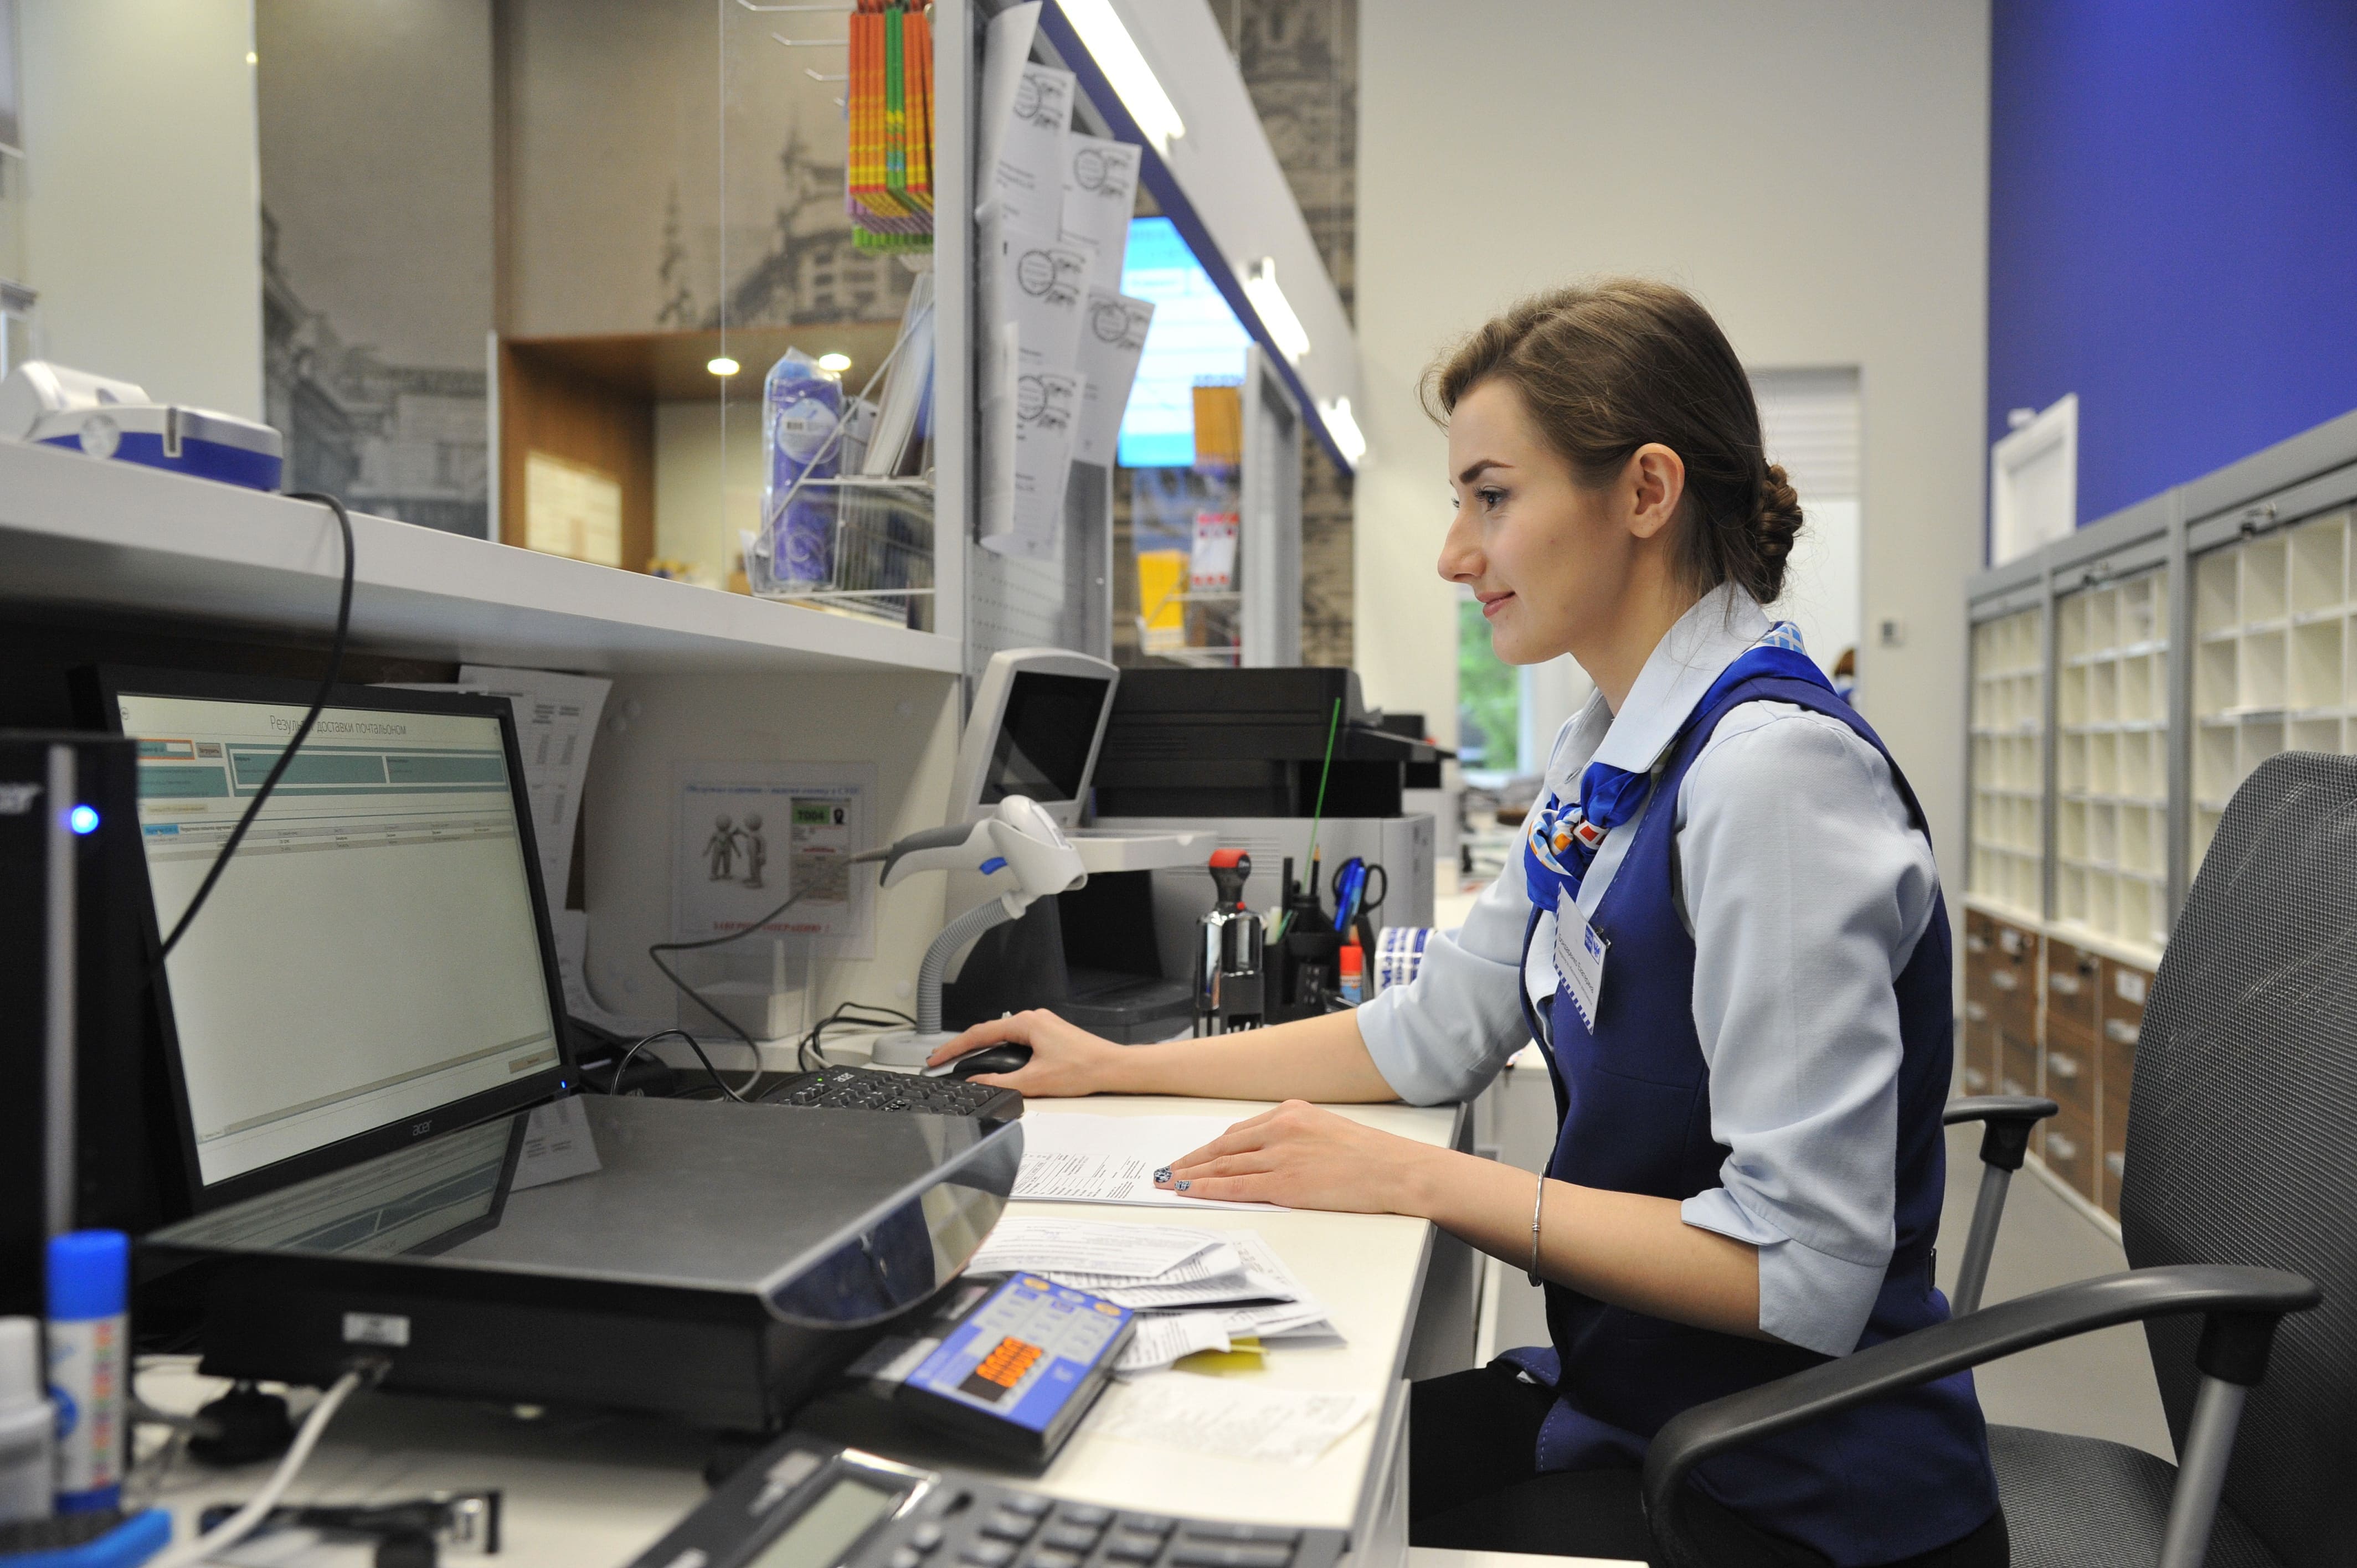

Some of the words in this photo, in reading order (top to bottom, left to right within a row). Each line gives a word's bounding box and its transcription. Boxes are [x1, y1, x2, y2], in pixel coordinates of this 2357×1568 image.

[317, 721, 354, 734] доставки
[356, 723, 407, 735] почтальоном
[413, 1120, 432, 1136] acer
